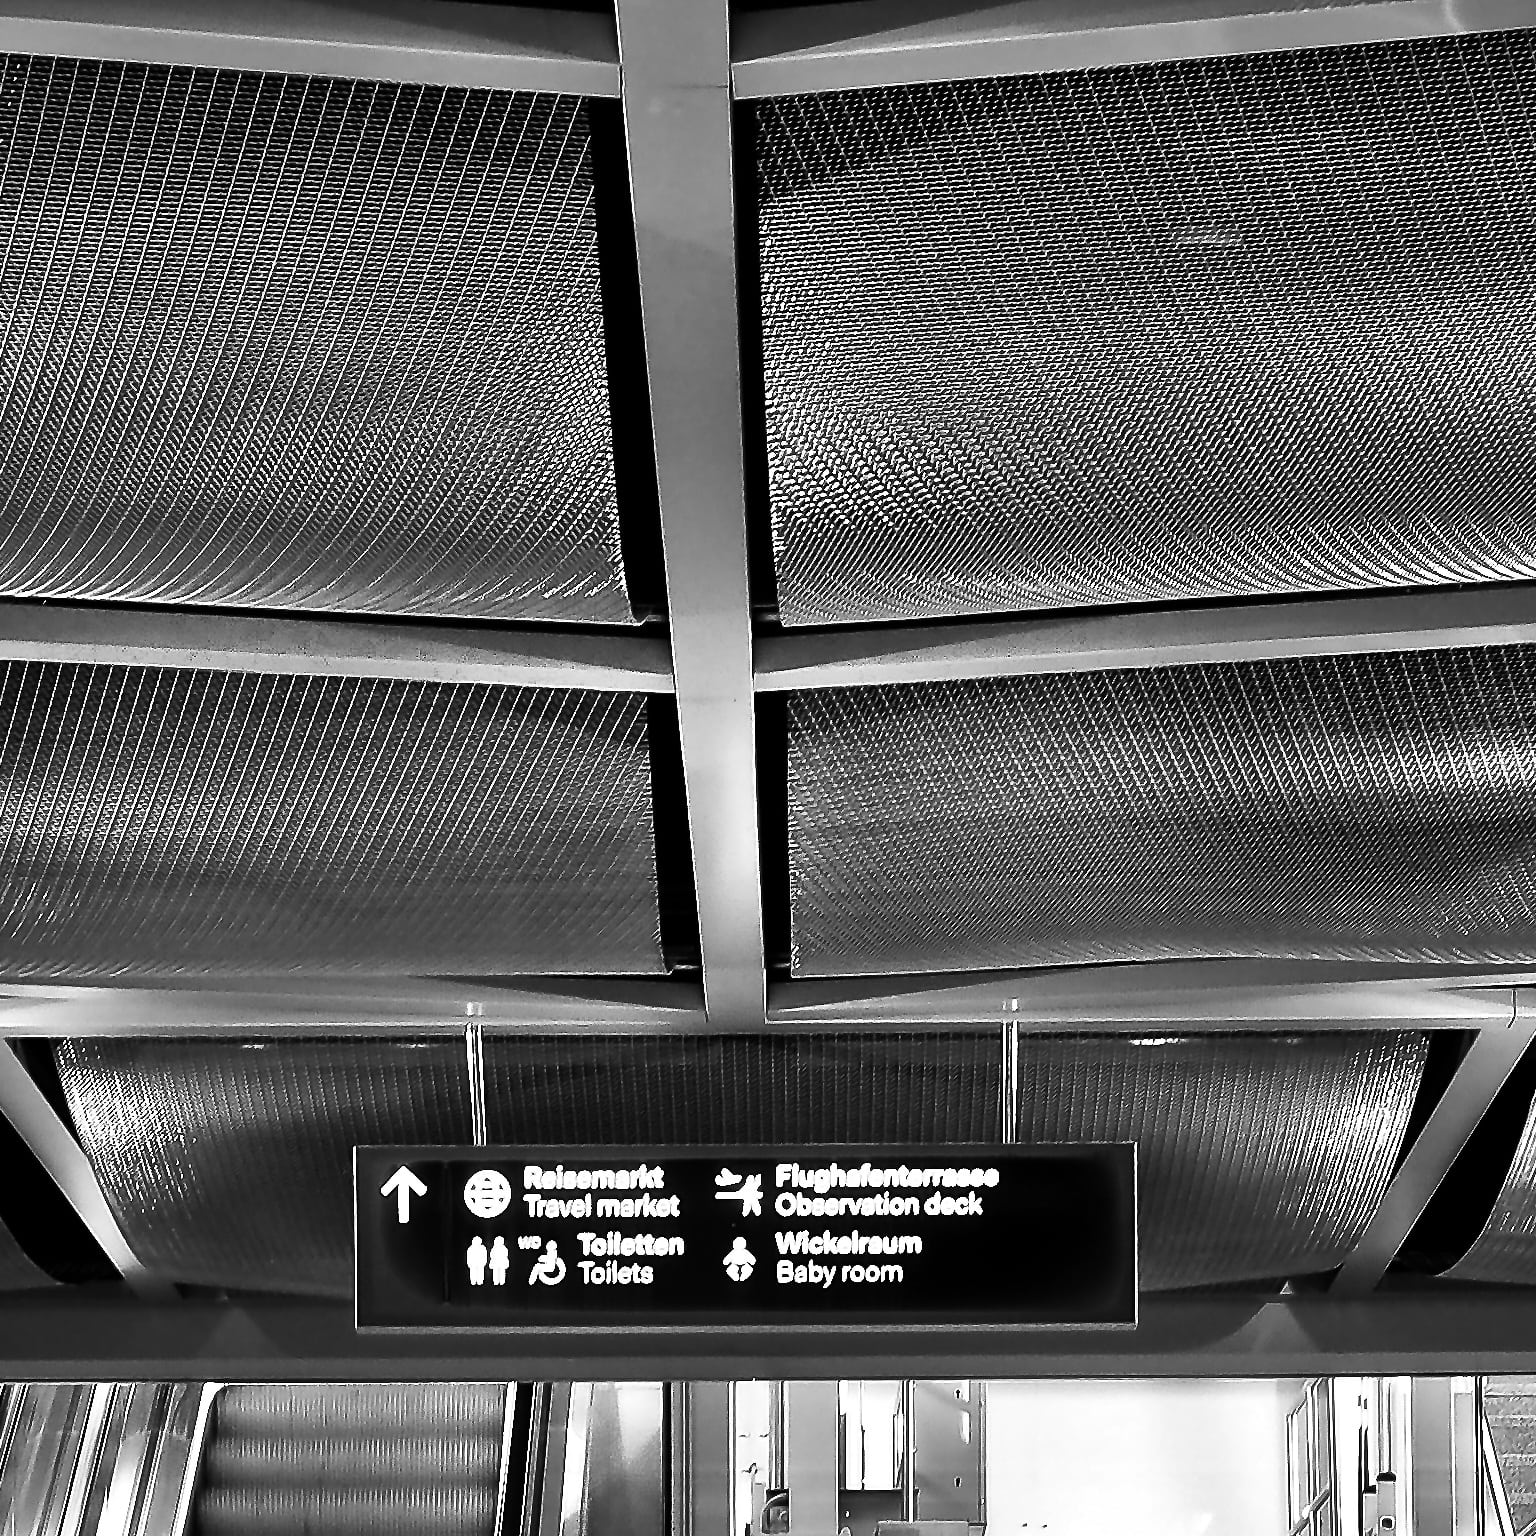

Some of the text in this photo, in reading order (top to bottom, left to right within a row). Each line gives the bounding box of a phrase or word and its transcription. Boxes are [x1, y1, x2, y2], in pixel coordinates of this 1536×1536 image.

[523, 1164, 665, 1190] Reisemarkt
[775, 1162, 1000, 1194] Flughafenterrasse
[522, 1192, 681, 1218] Travel market
[774, 1190, 984, 1217] Observation deck
[576, 1230, 685, 1257] Toiletten
[774, 1229, 923, 1255] Wickelraum
[576, 1259, 654, 1285] Toilets
[776, 1258, 904, 1289] Baby room
